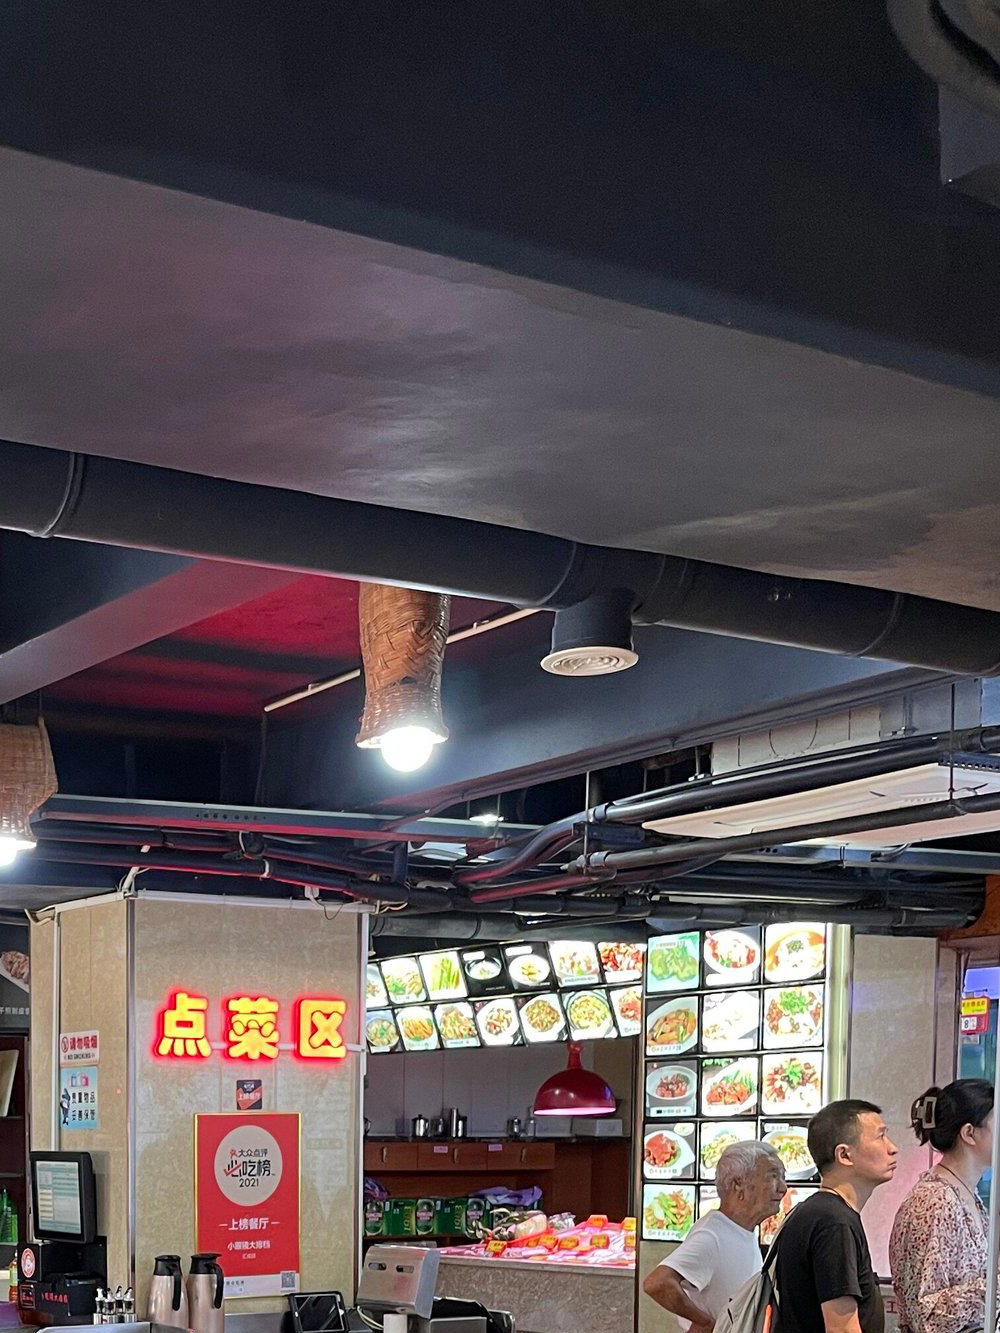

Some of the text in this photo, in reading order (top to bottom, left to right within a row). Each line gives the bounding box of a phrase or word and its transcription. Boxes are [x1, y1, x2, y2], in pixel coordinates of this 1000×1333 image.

[156, 992, 349, 1060] 点菜区
[238, 1148, 268, 1158] 大众点评
[223, 1159, 271, 1178] 必吃榜
[238, 1178, 260, 1188] 2021
[228, 1217, 269, 1231] 上榜餐厅
